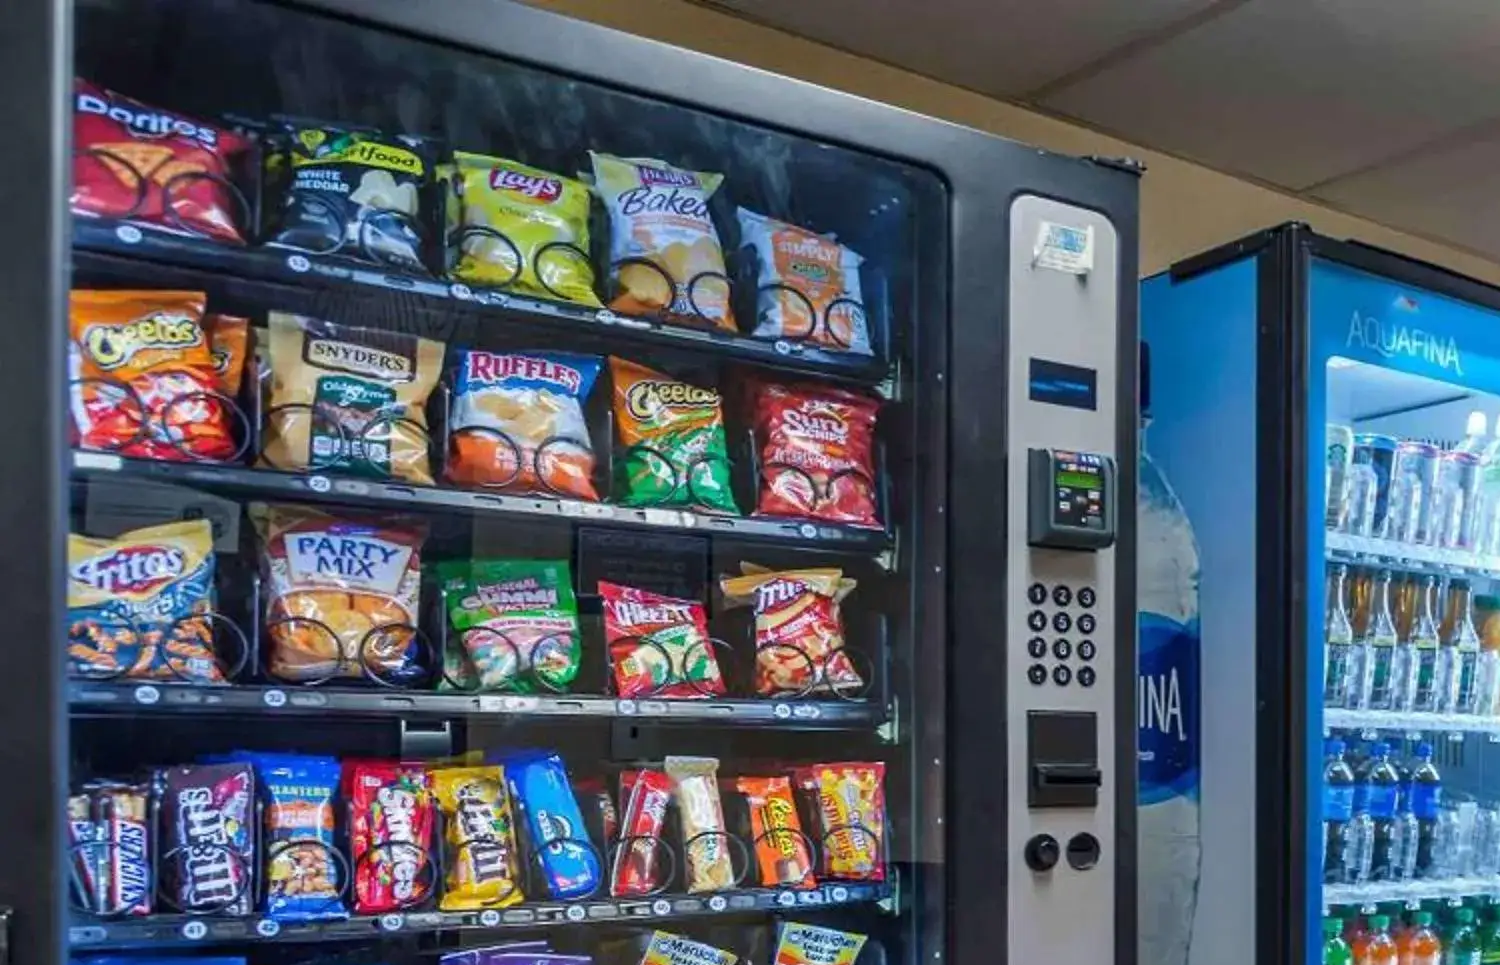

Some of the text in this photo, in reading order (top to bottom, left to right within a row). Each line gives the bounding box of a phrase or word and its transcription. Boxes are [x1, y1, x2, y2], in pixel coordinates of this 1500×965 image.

[78, 94, 217, 144] Doritos
[89, 319, 195, 365] Cheetos
[1346, 311, 1463, 376] AQUAFINA
[470, 352, 581, 394] RUFFLES
[630, 382, 720, 419] Cheetos
[71, 548, 184, 591] Fritos
[297, 536, 402, 565] PARTY
[316, 555, 376, 580] MIX
